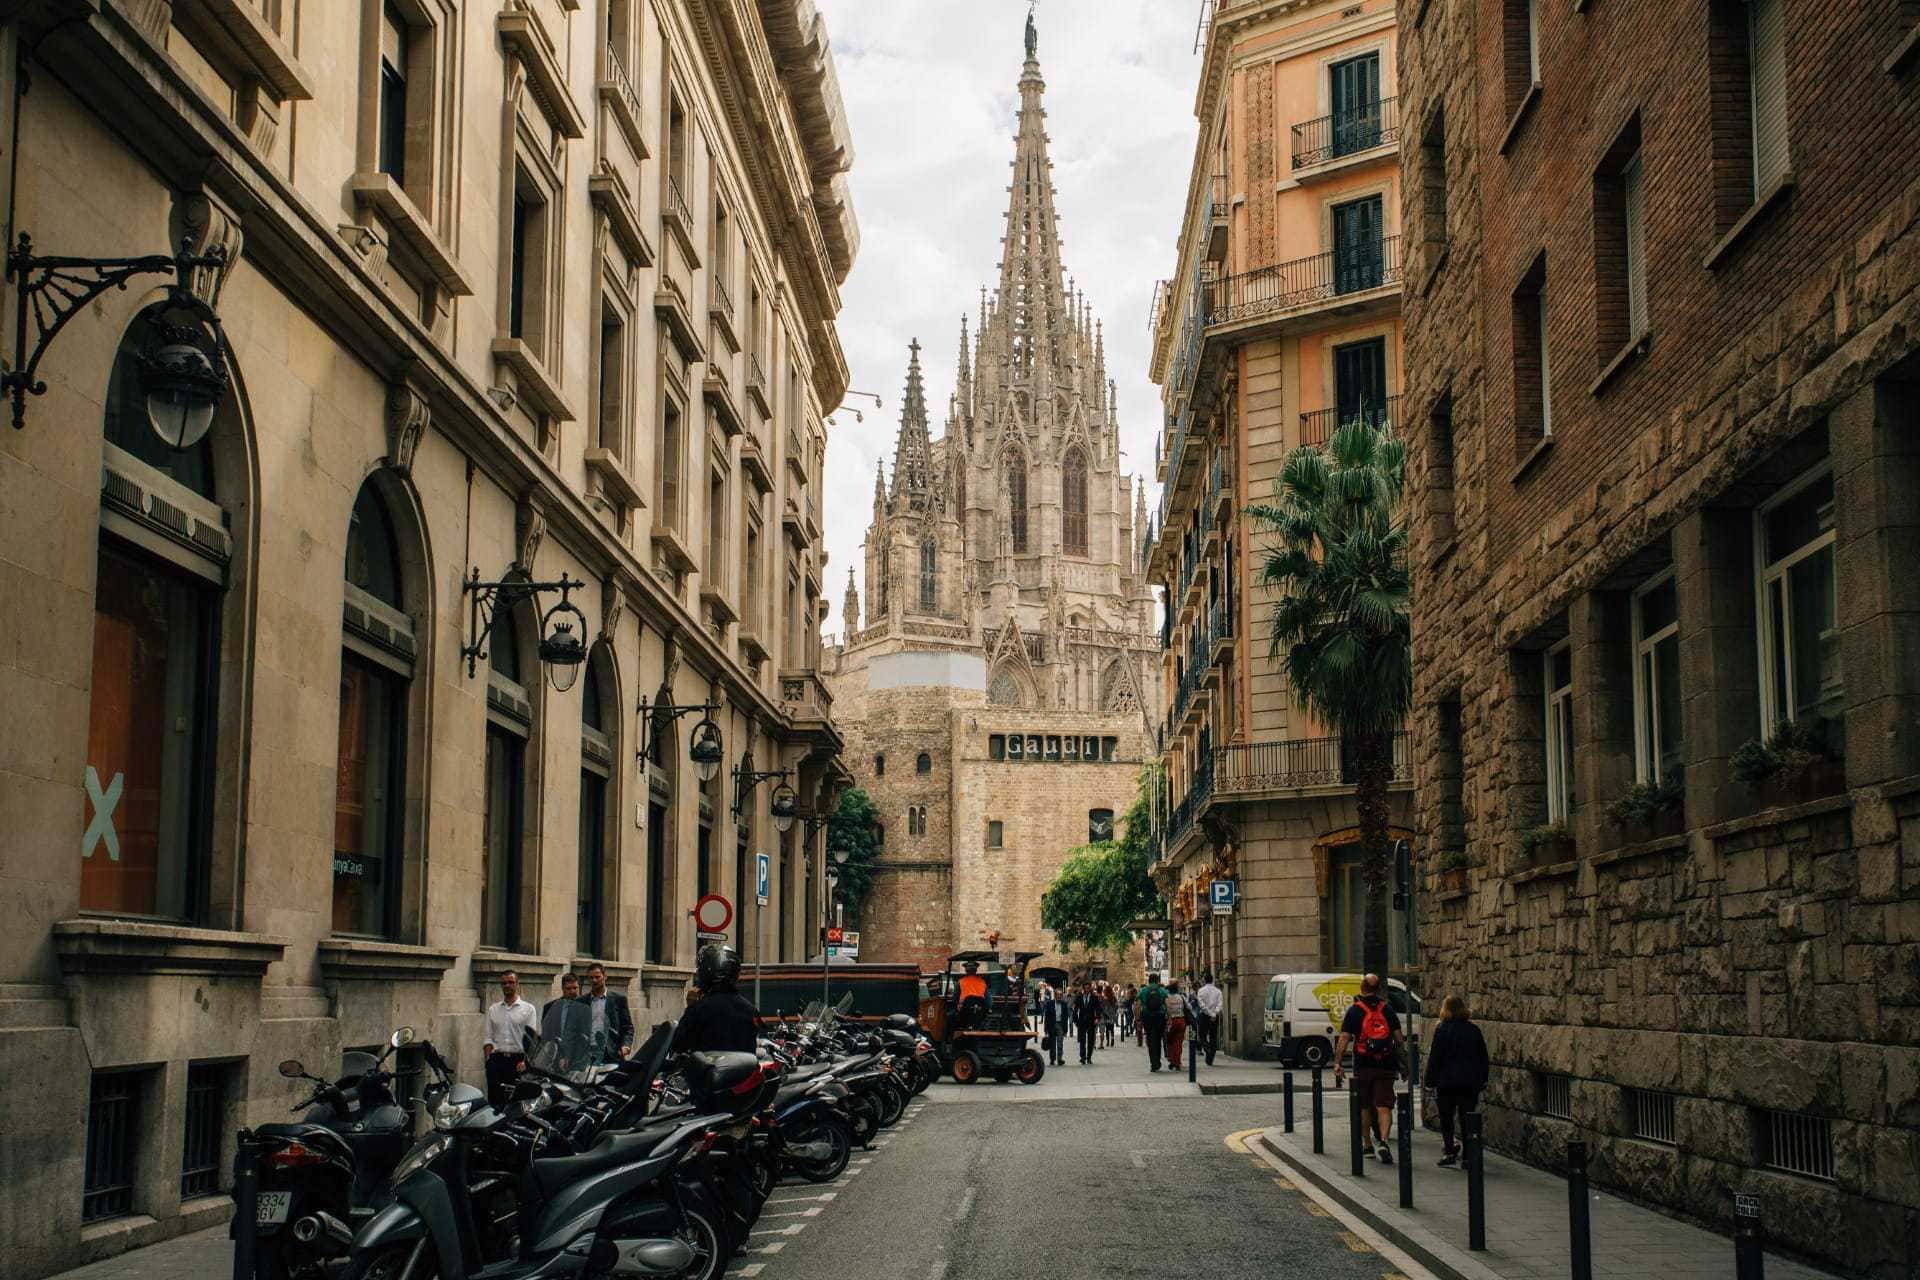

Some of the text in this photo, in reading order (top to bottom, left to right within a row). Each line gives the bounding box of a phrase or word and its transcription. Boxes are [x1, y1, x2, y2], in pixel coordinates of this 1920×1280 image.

[82, 765, 124, 861] X
[760, 860, 767, 892] P
[1215, 884, 1230, 903] P
